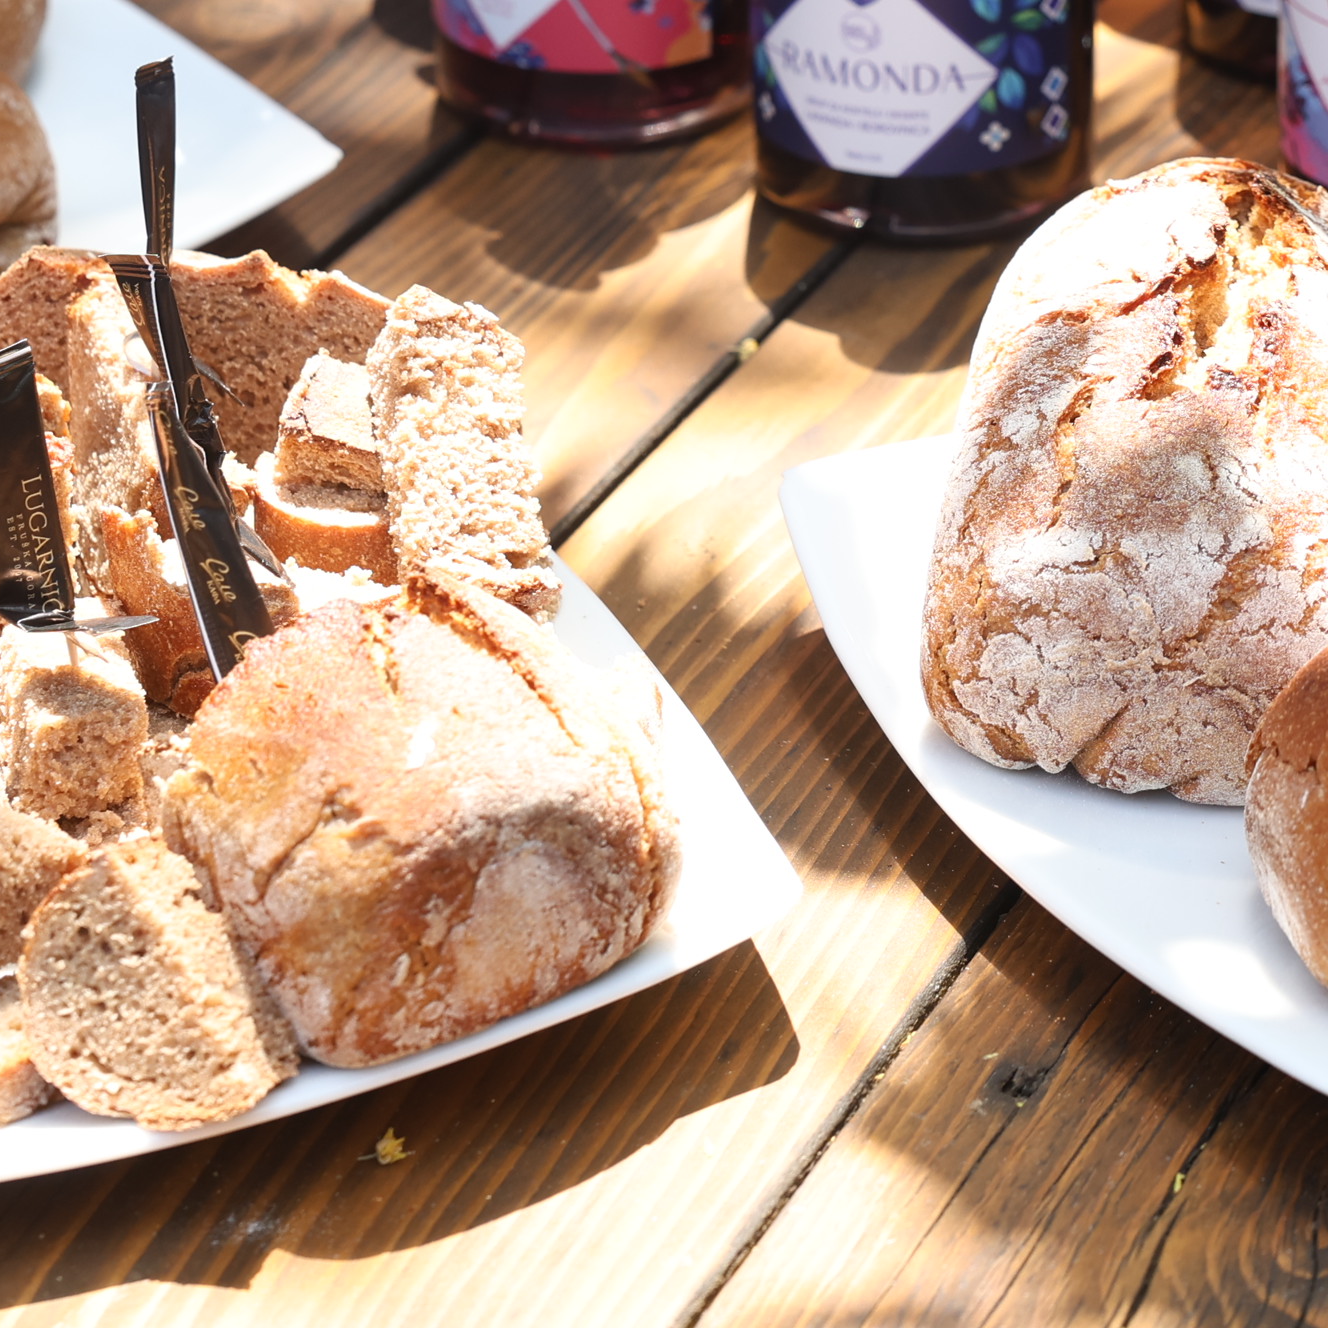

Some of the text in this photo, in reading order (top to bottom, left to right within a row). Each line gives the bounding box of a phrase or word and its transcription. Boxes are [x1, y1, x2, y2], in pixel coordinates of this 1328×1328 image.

[781, 39, 965, 96] RAMONDA
[6, 516, 23, 583] EST. 2007
[16, 513, 36, 610] FRUŠKA GORA
[21, 473, 66, 614] LUGARNIC
